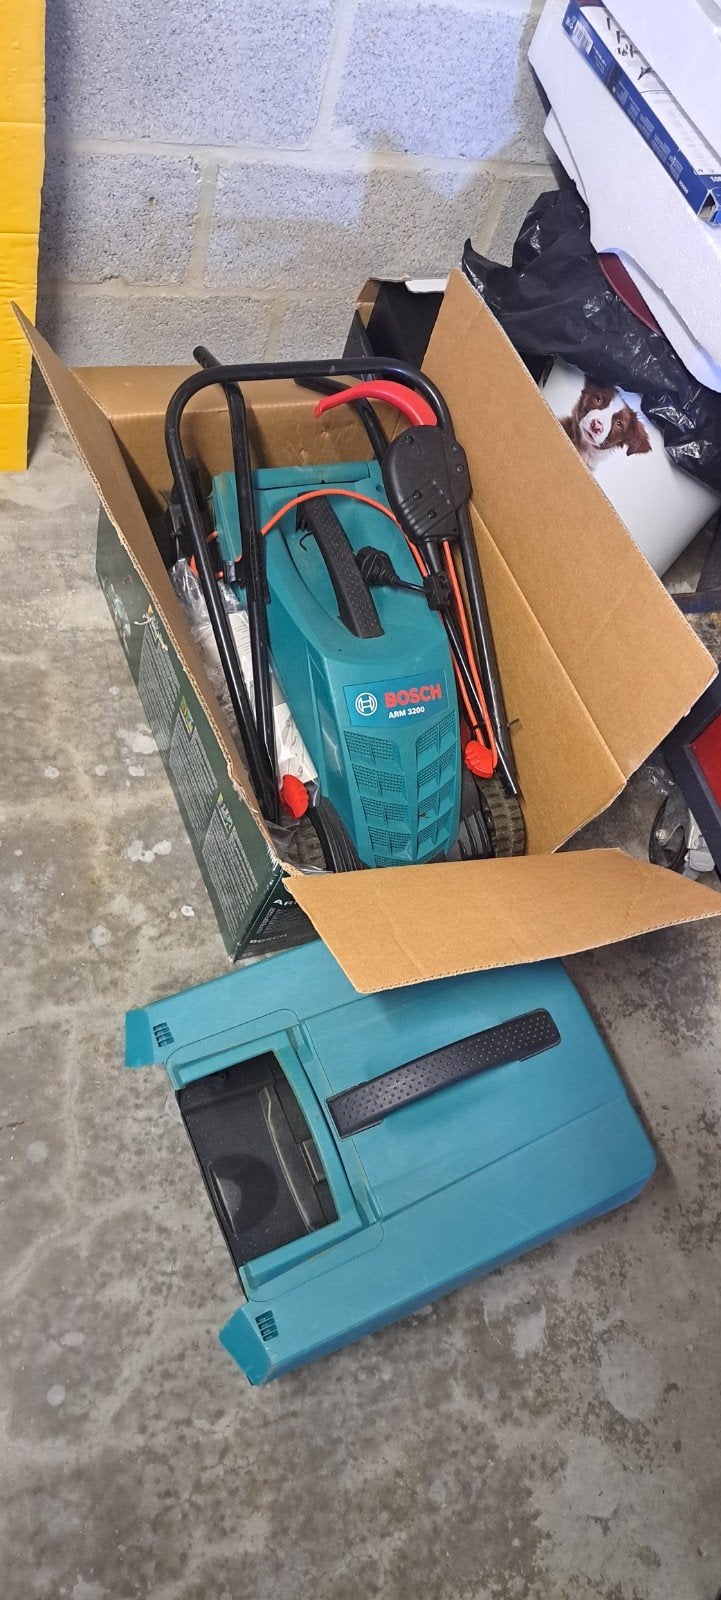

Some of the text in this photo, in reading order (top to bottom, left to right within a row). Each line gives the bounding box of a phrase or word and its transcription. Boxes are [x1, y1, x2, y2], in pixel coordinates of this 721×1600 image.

[384, 684, 442, 708] BOSCH
[388, 706, 426, 719] ARM 3200
